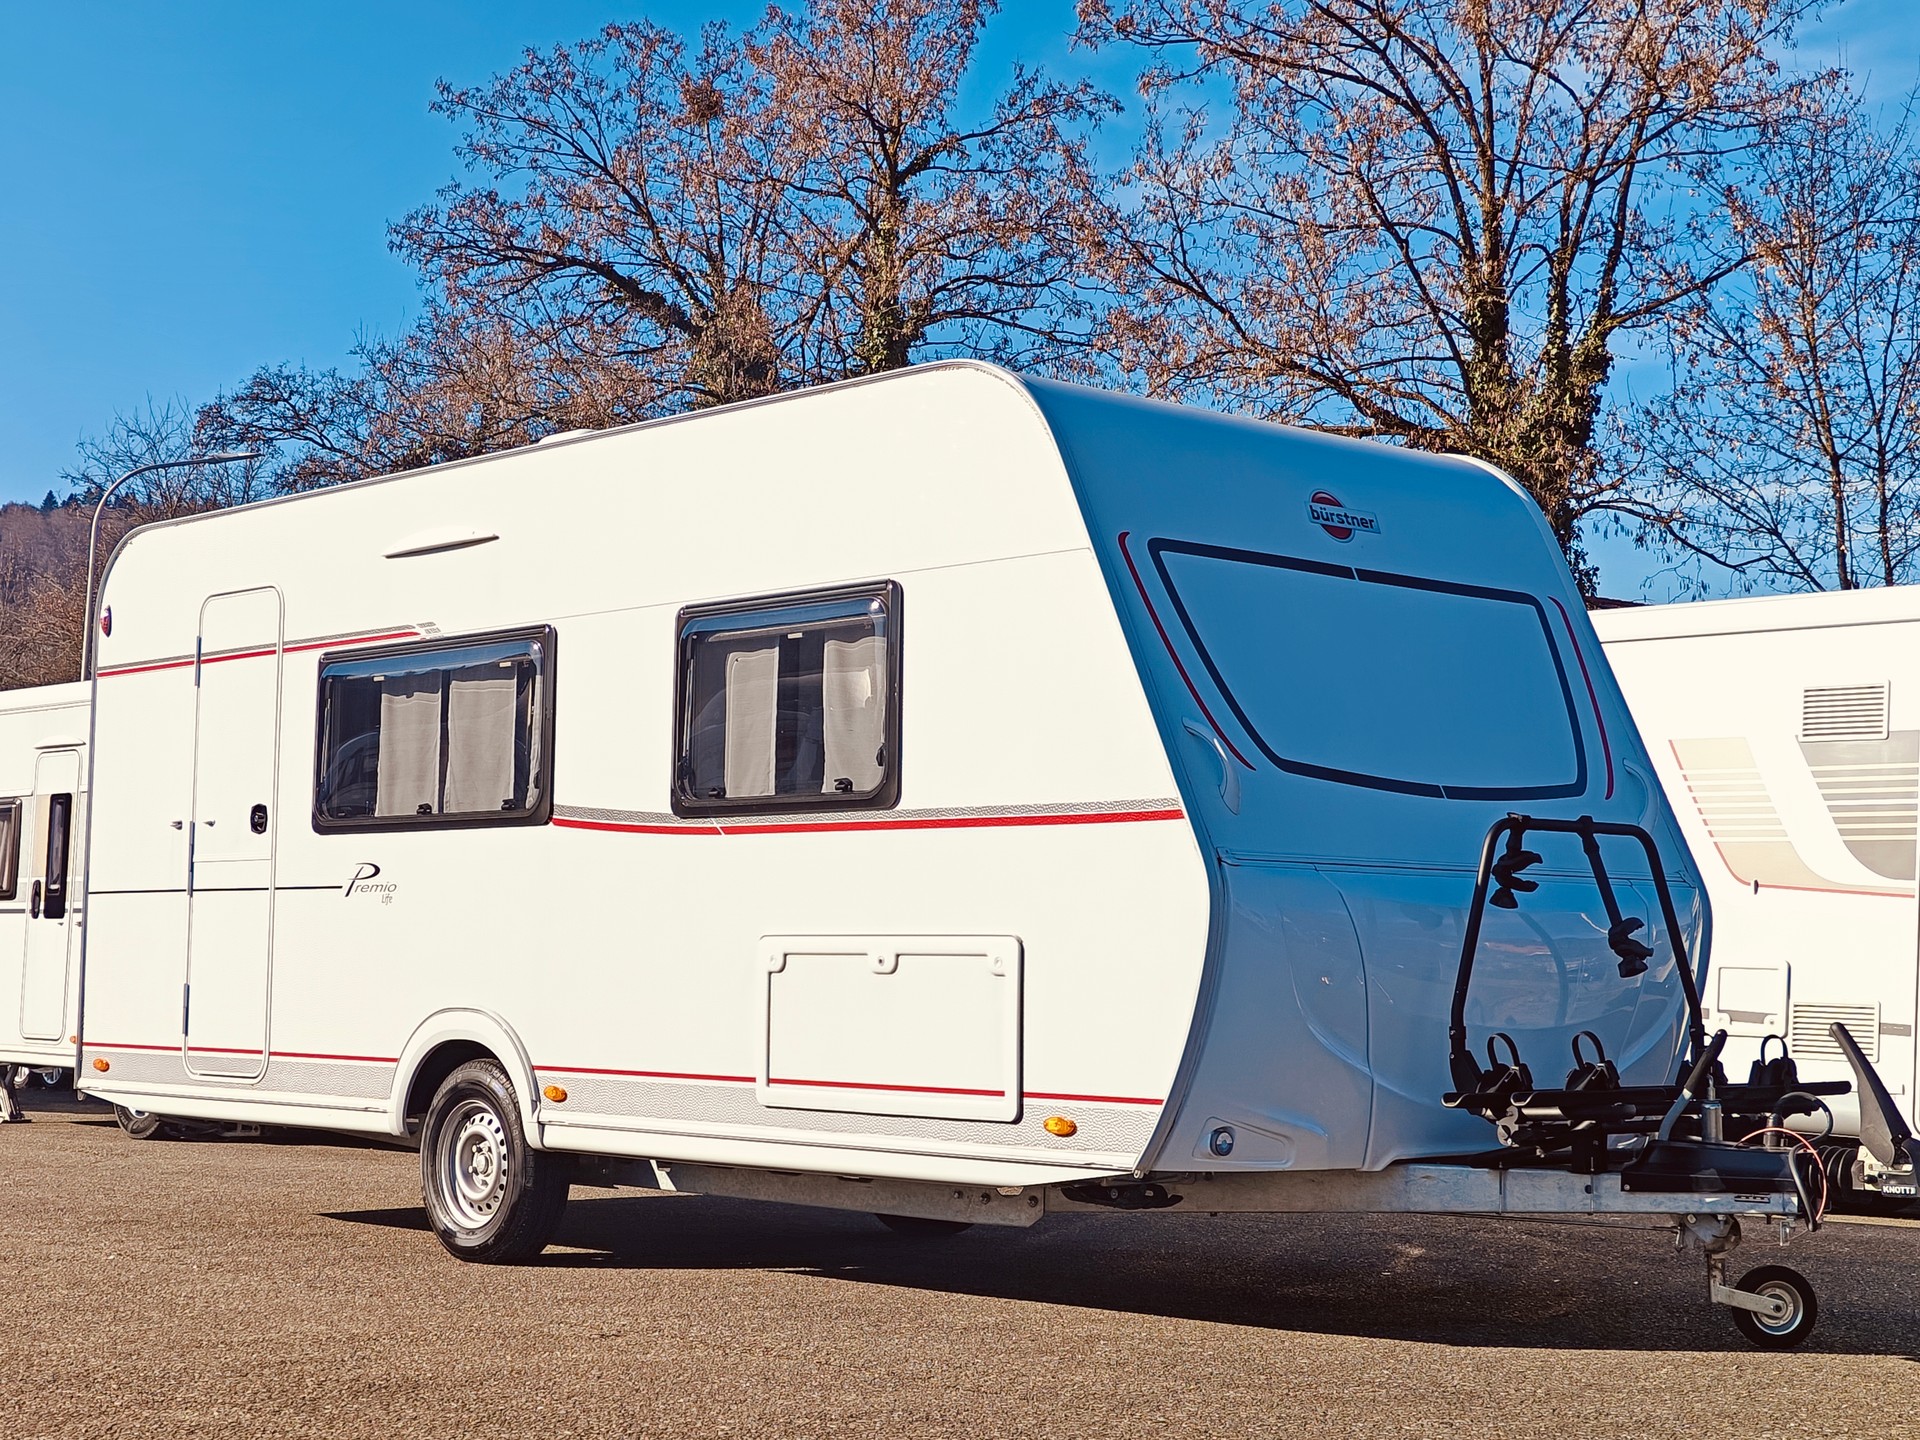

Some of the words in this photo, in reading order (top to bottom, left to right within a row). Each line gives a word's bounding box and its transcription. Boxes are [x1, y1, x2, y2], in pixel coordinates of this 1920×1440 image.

[1309, 504, 1375, 530] bürstner
[345, 862, 397, 898] Premio
[381, 893, 393, 906] Life
[1882, 1185, 1911, 1195] KNOTT
